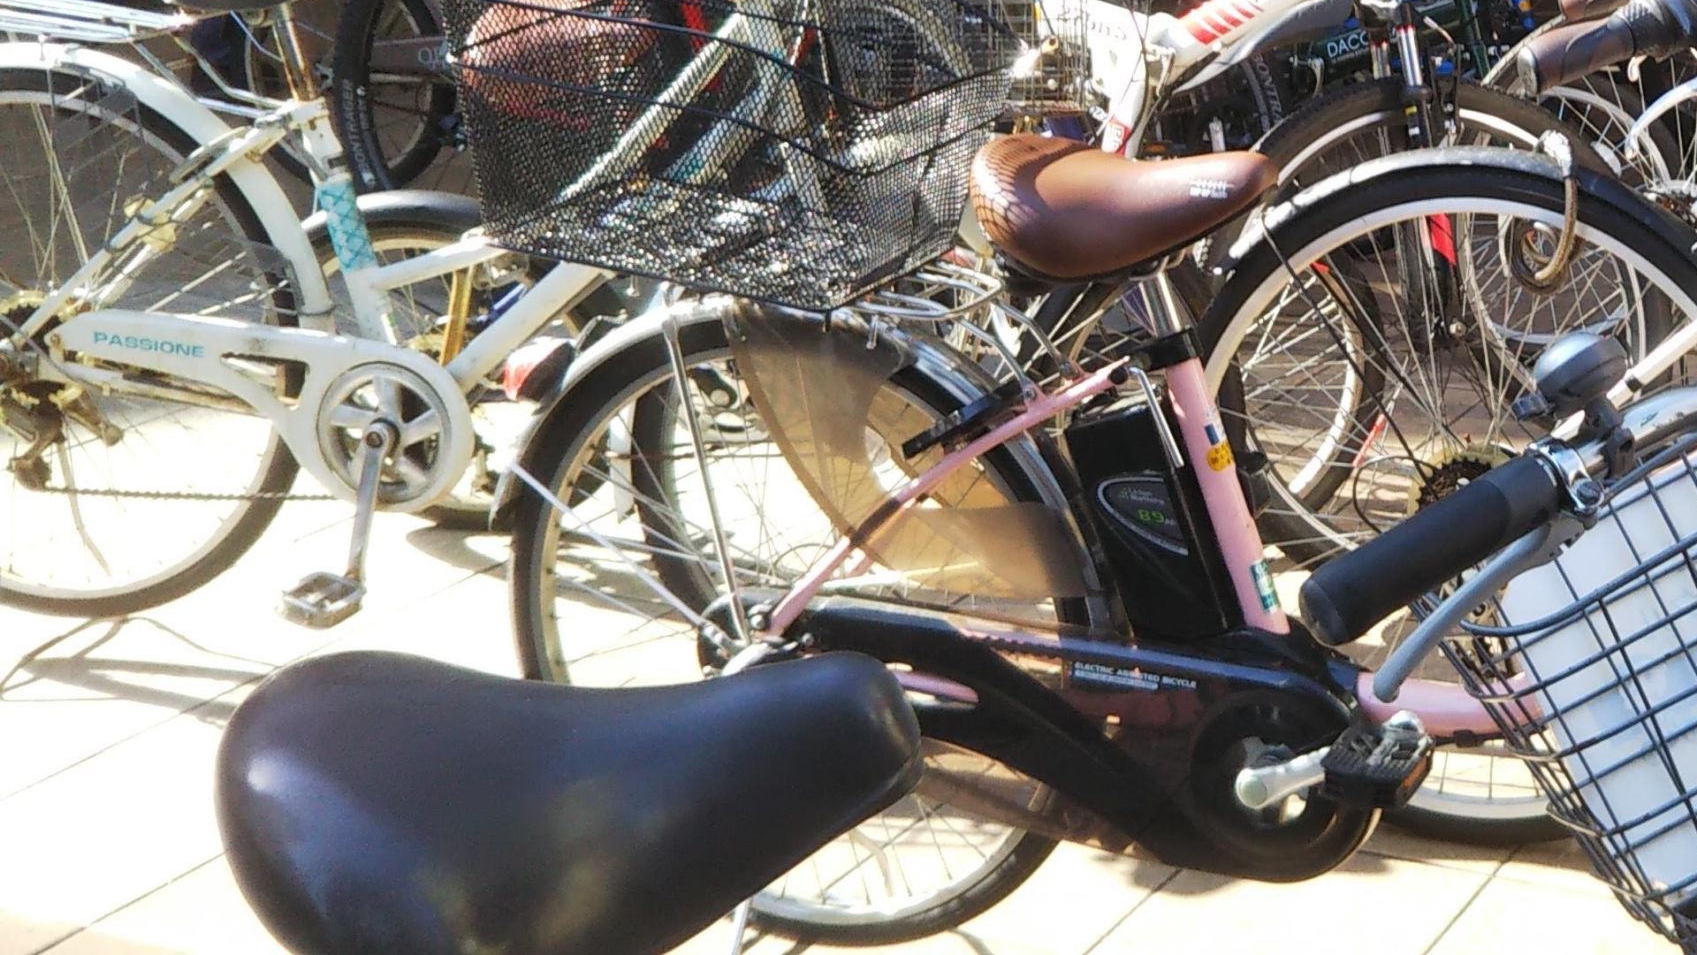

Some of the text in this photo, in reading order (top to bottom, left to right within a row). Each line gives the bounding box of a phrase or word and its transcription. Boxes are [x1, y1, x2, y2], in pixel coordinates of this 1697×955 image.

[93, 331, 205, 358] PASSIONE
[1074, 661, 1115, 674] ELECTRIC
[1162, 675, 1198, 689] BICYCLE
